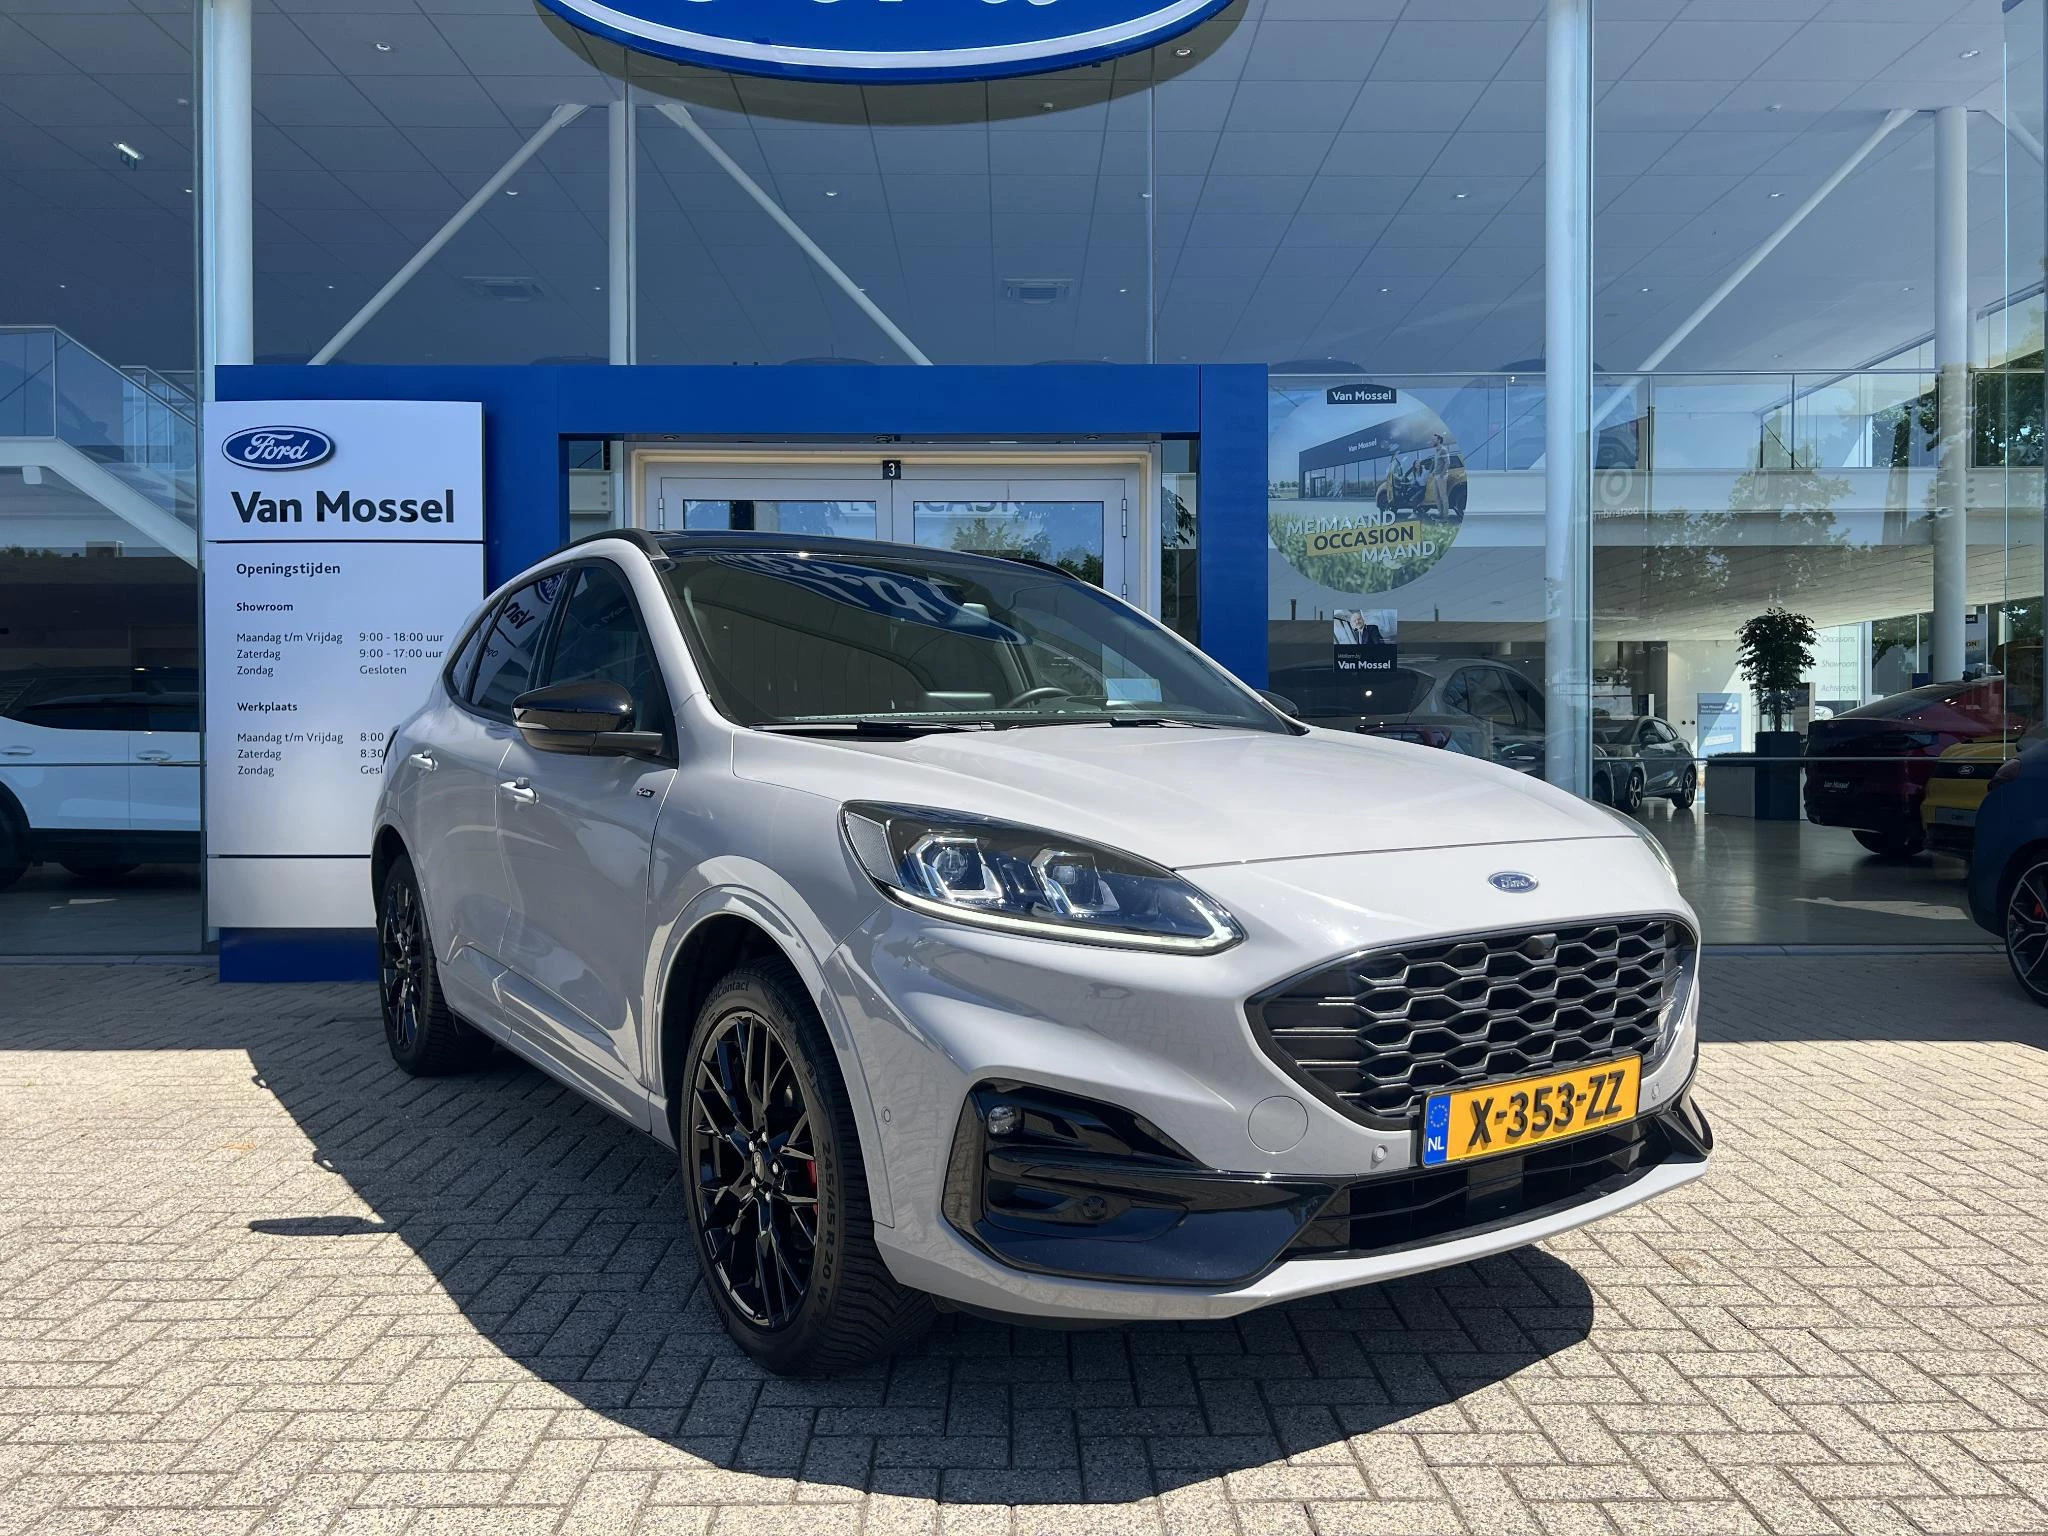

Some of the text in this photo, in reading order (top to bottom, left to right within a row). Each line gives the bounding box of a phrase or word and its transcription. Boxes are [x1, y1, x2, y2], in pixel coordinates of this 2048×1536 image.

[1332, 389, 1392, 401] Van Mossel
[244, 433, 310, 461] Ford
[888, 463, 896, 477] 3
[231, 489, 454, 523] Van Mossel
[1286, 510, 1396, 537] MEIMAAND
[1314, 526, 1414, 550] OCCASION
[1361, 541, 1436, 563] MAAND
[236, 563, 341, 578] Openingstijden
[236, 602, 294, 612] Showroom
[236, 633, 282, 645] Maandag
[284, 632, 302, 642] t/m
[306, 632, 343, 645] Vrijdag
[359, 633, 383, 642] 9:00
[394, 633, 424, 642] 18:00
[426, 634, 444, 642] uur
[236, 649, 281, 661] Zaterdag
[359, 649, 383, 658] 9:00
[394, 649, 423, 658] 17:00
[425, 650, 444, 658] uur
[236, 665, 407, 677] Zondag Gesloten
[1338, 660, 1391, 669] Van Mossel
[236, 702, 298, 714] Werkplaats
[237, 732, 384, 745] Maandag t/m Vrijdag 8:00
[237, 749, 384, 761] Zaterdag 8:30
[237, 765, 383, 777] Zondag Gesl
[1468, 1069, 1626, 1148] X-353-ZZ
[1427, 1137, 1445, 1152] NL
[821, 1142, 837, 1226] 245/45
[825, 1231, 836, 1248] R
[822, 1254, 834, 1281] 20
